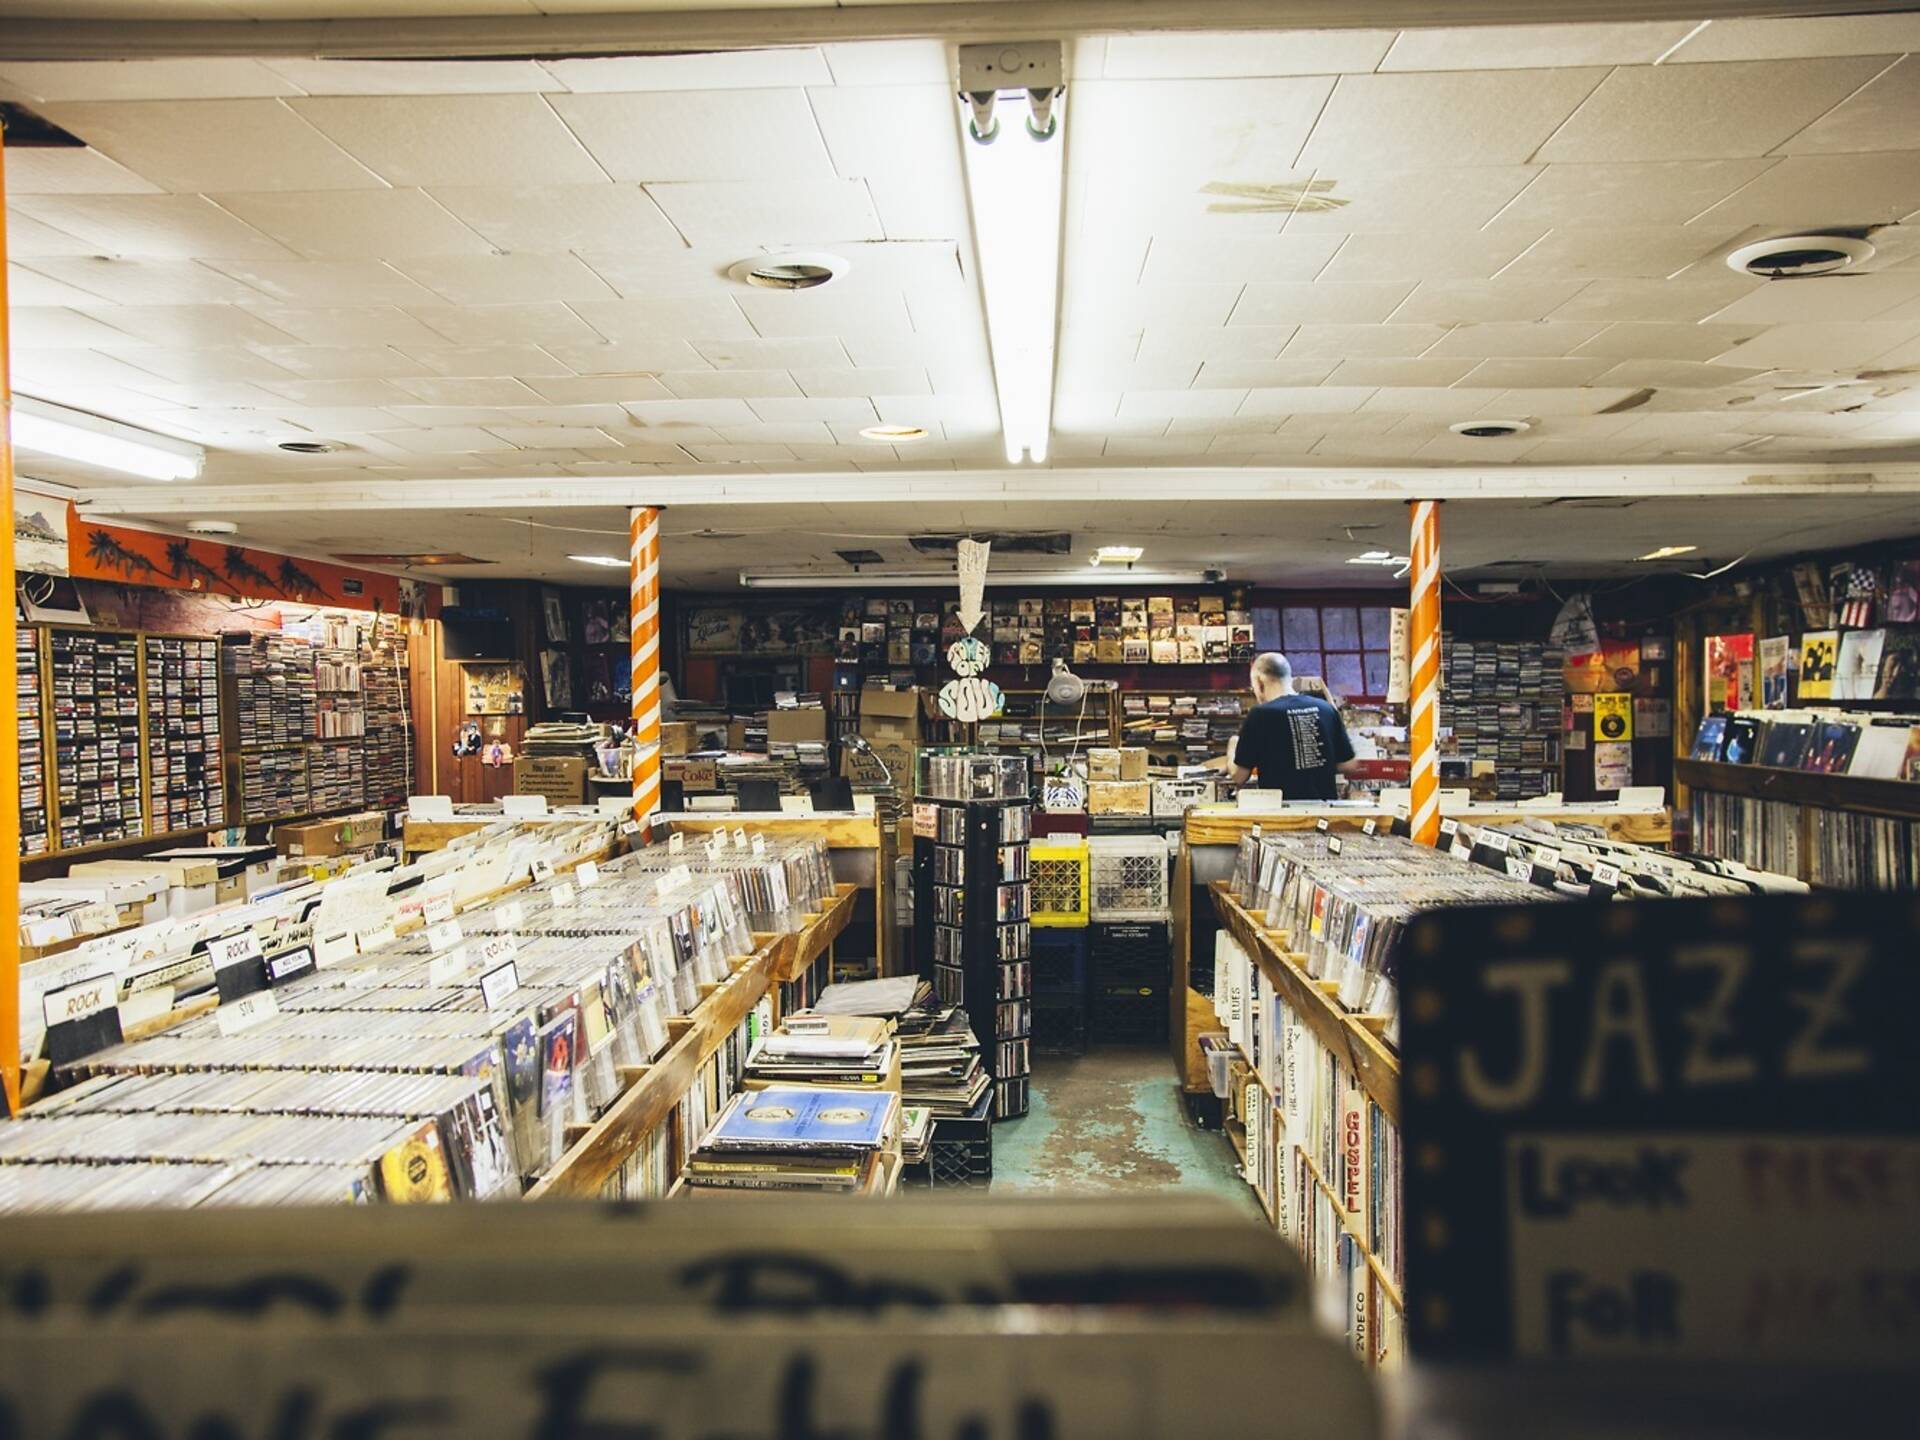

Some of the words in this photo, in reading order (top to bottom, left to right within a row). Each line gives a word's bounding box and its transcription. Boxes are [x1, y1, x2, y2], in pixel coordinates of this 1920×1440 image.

[938, 677, 1005, 723] SOUL
[681, 767, 713, 782] Coke
[225, 938, 251, 961] ROCK
[484, 938, 512, 959] ROCK
[66, 987, 102, 1016] ROCK
[1231, 986, 1241, 1021] BLUES
[1459, 939, 1870, 1112] JAZZ
[1248, 1118, 1256, 1167] OLDIES
[1346, 1110, 1360, 1213] GOSPEL
[1280, 1203, 1288, 1239] LDIES
[1355, 1292, 1366, 1352] ZYDECO
